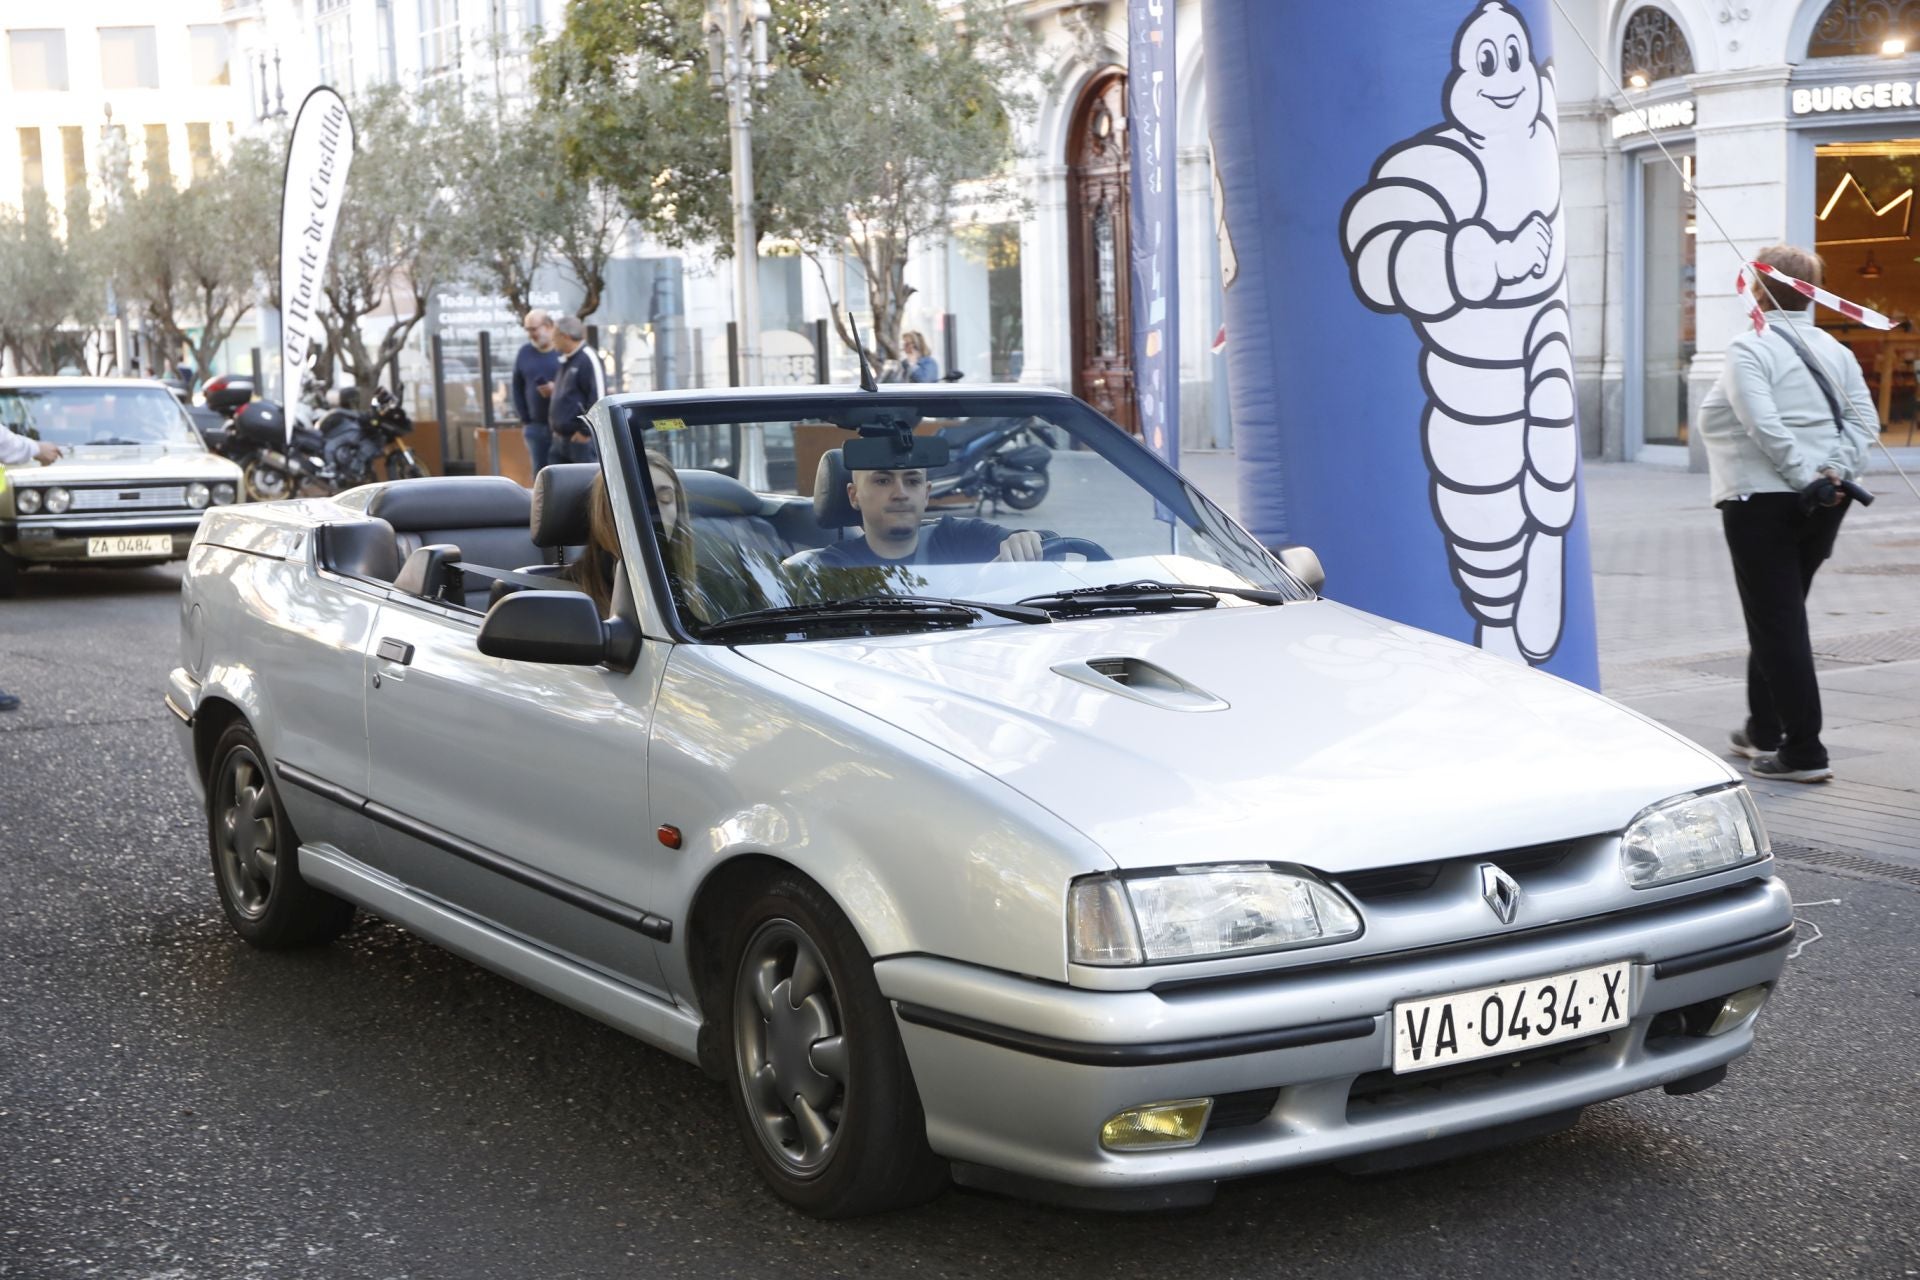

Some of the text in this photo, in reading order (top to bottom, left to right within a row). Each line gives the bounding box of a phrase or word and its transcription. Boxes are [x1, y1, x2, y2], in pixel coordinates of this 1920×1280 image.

[1792, 82, 1913, 114] BURGER
[286, 104, 344, 367] El Norte de Castilla
[437, 293, 473, 308] Todo
[438, 310, 492, 324] cuando
